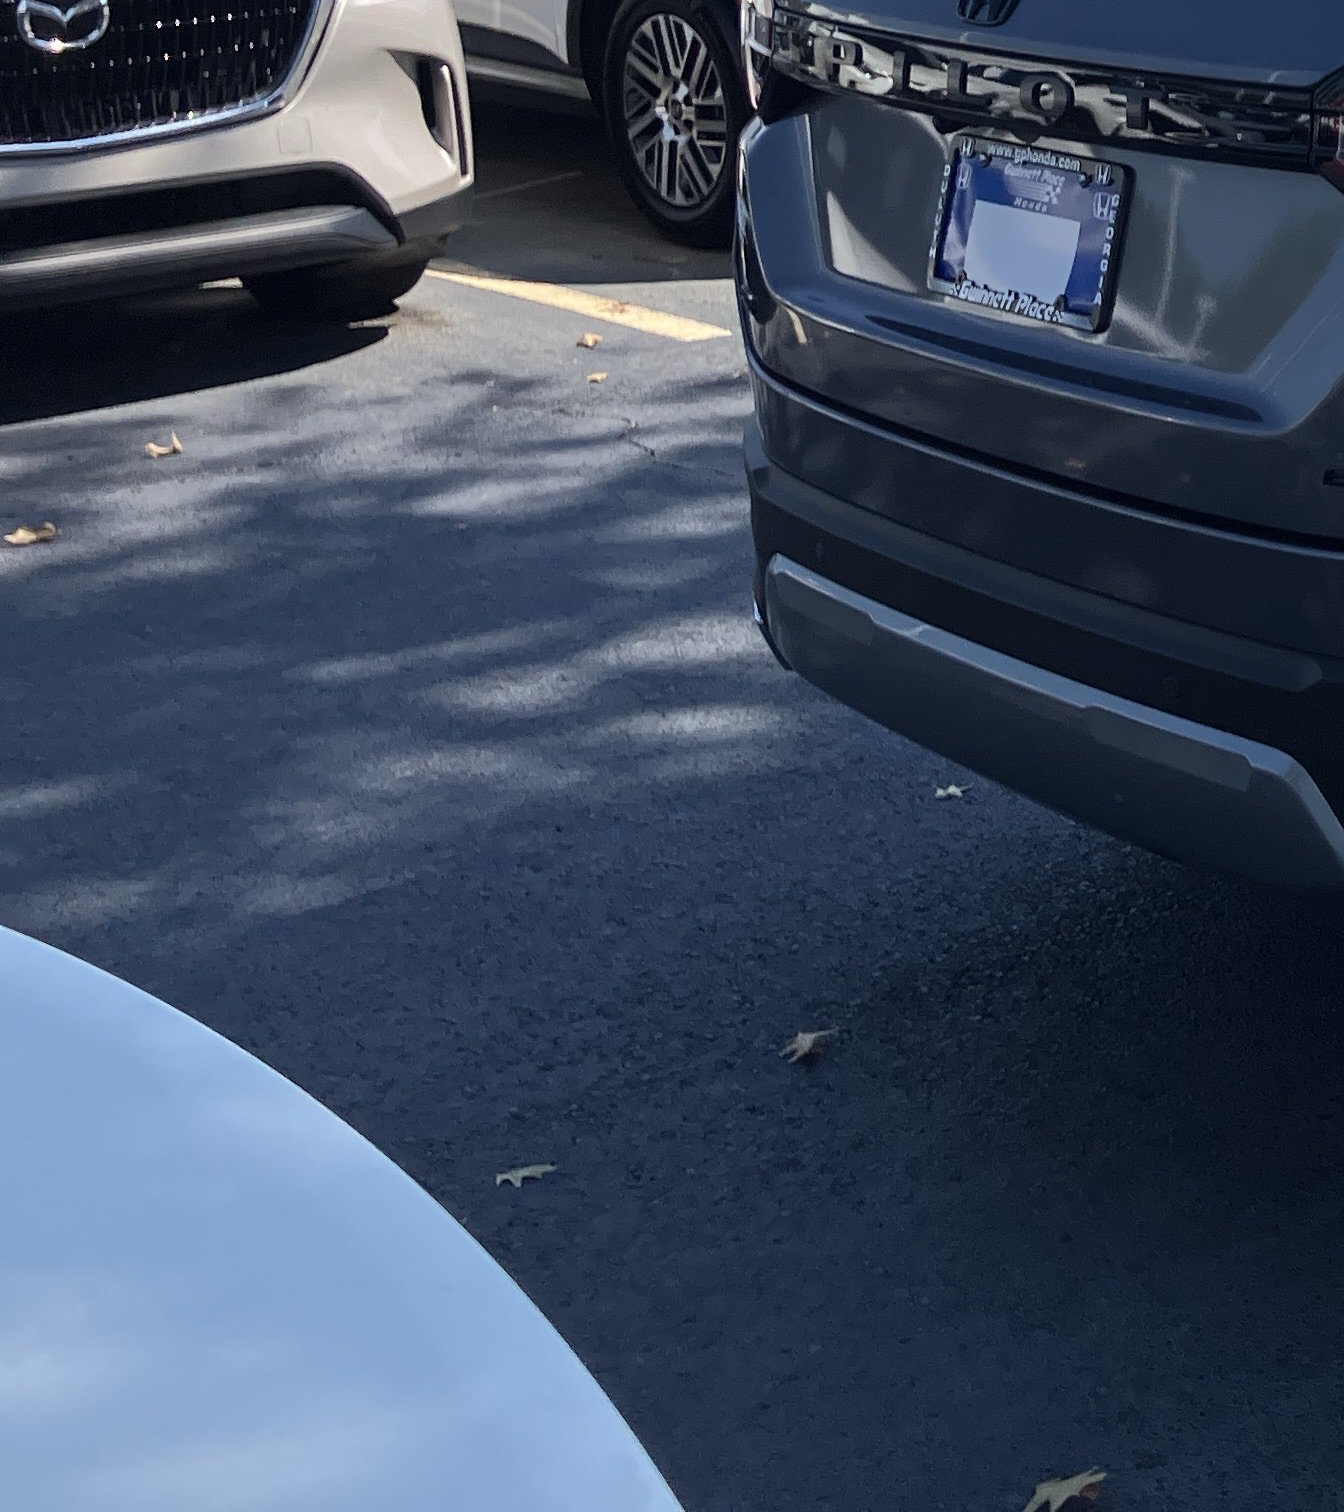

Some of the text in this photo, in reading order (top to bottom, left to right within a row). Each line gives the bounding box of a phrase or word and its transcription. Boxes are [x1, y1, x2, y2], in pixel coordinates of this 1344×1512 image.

[818, 35, 1169, 130] PILOT
[987, 142, 1082, 172] www.gphonda.com
[1093, 193, 1120, 306] GEORGIA
[958, 280, 1056, 322] Gwinnett Place
